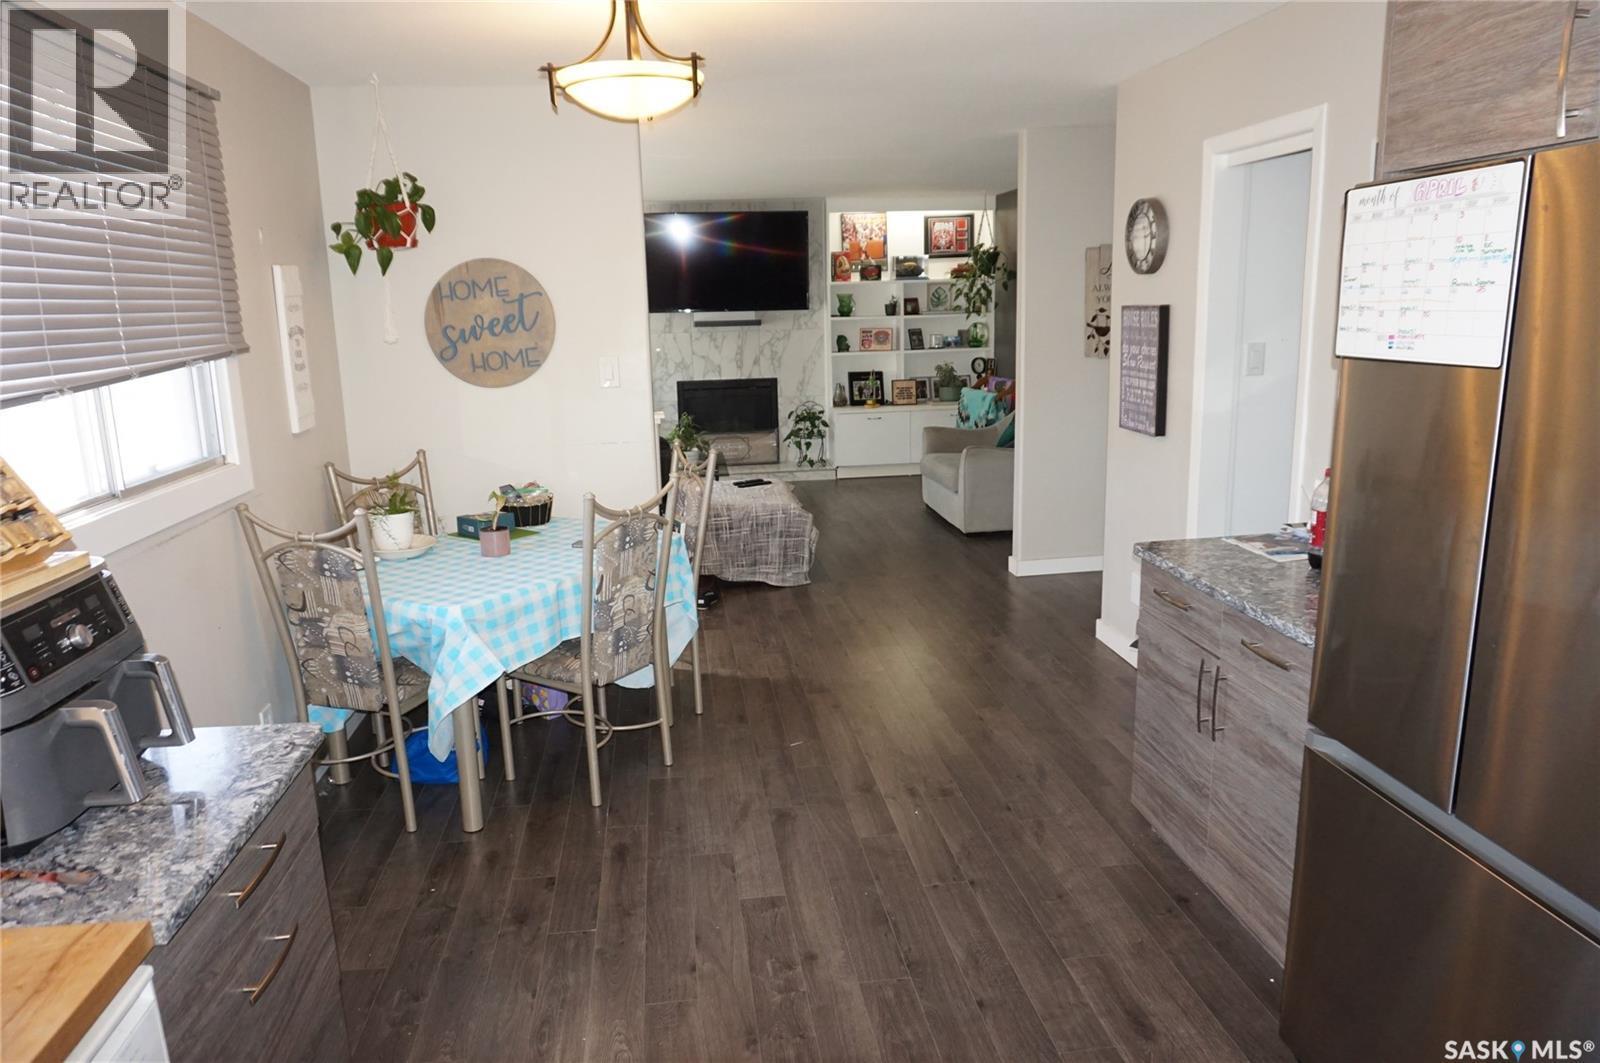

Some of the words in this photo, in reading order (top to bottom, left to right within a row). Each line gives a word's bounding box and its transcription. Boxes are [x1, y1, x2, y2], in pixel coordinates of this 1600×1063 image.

[1415, 177, 1467, 201] APRIL
[439, 276, 509, 302] HOME
[440, 291, 543, 363] sweet
[470, 346, 541, 373] HOME
